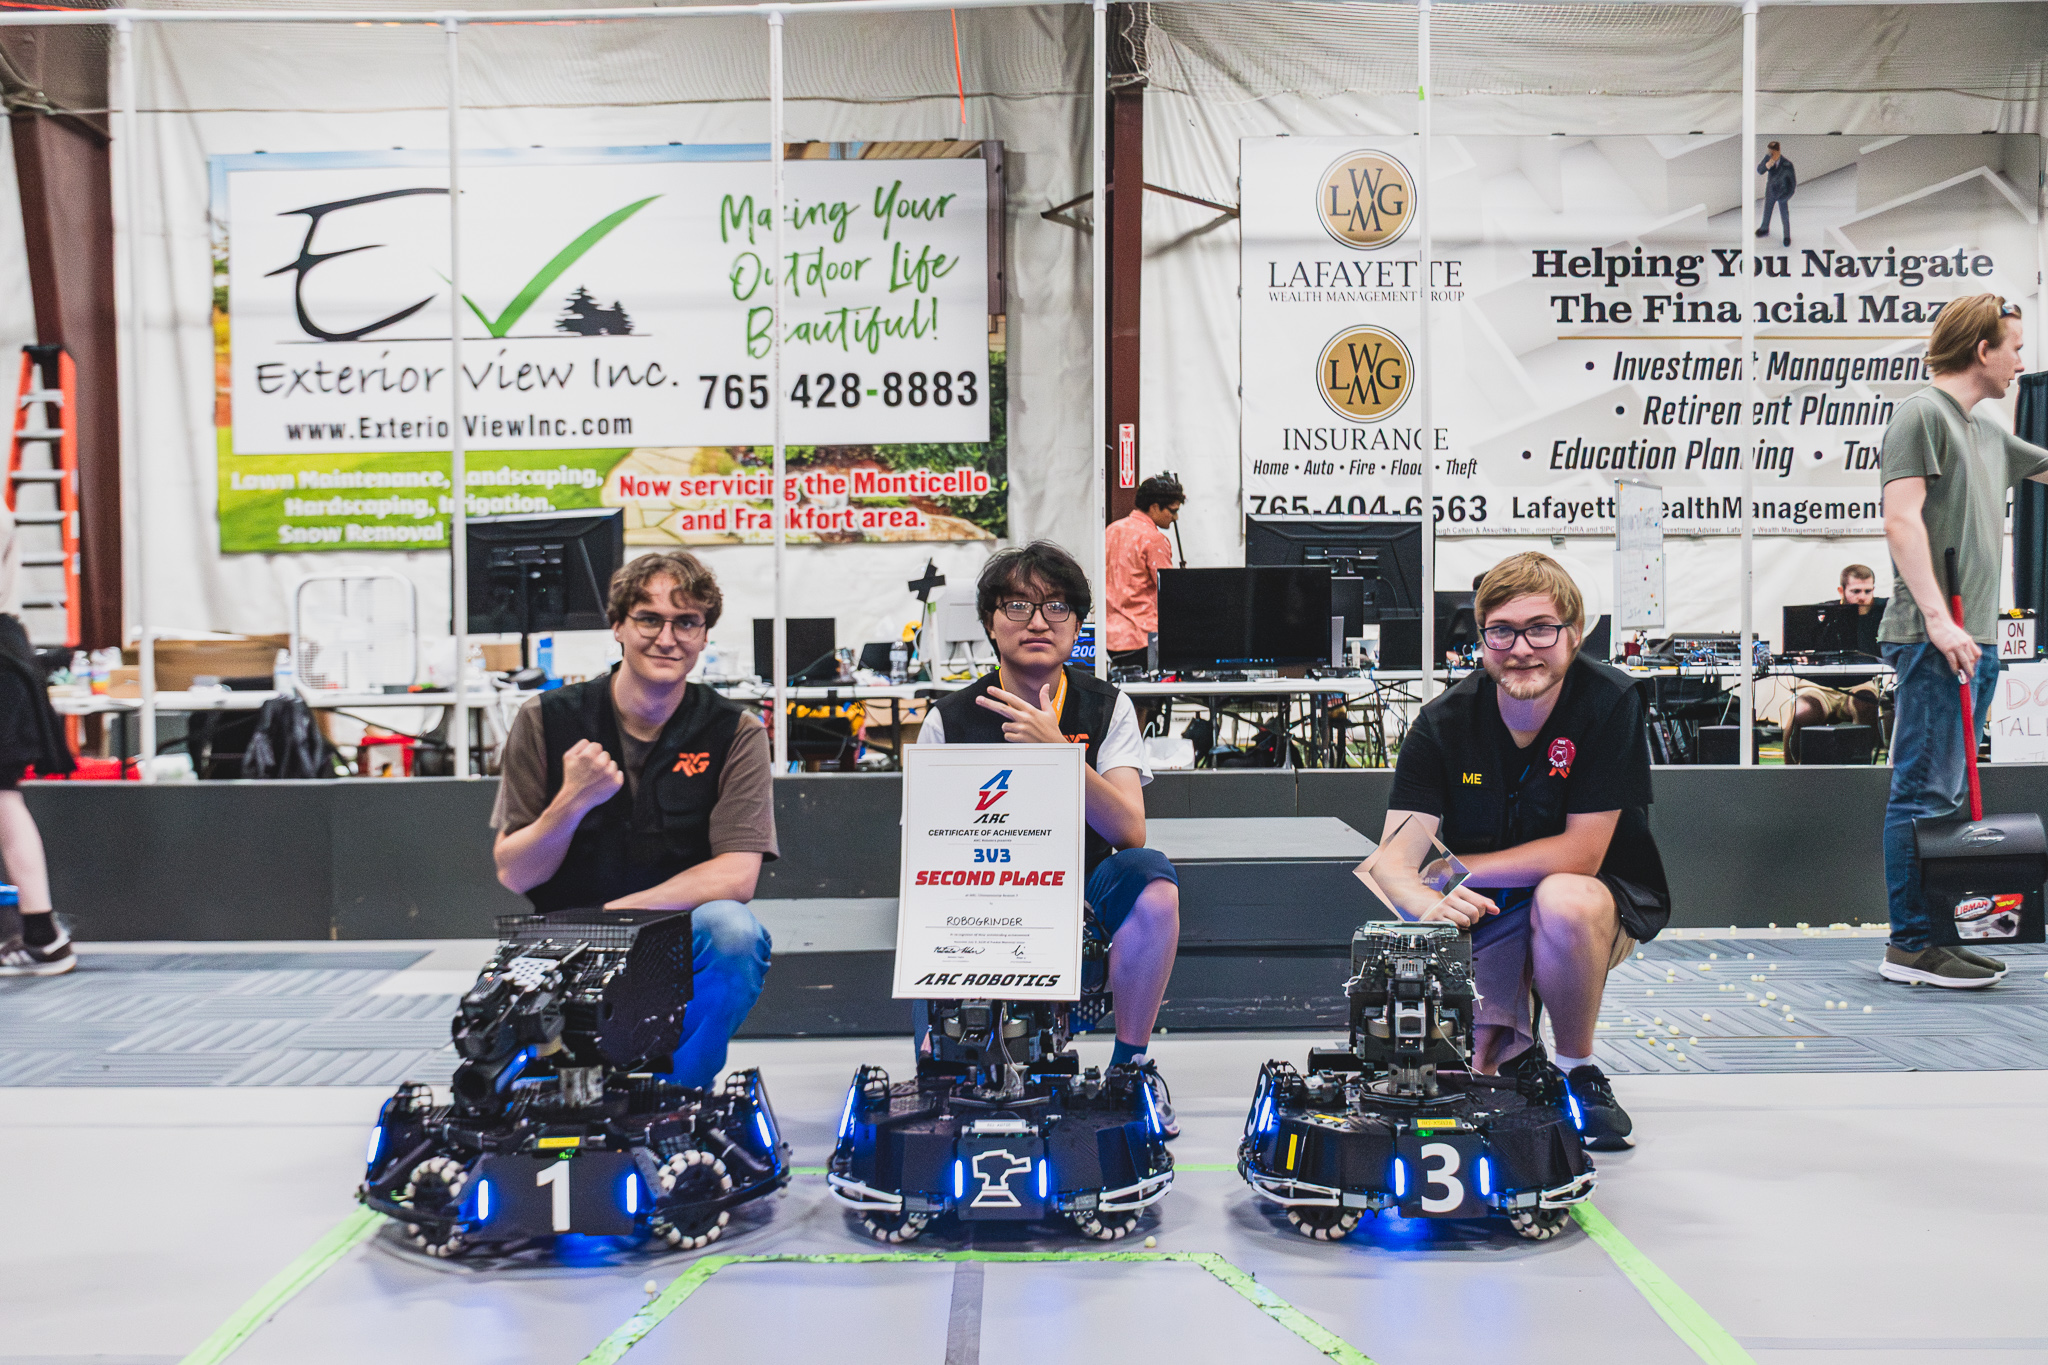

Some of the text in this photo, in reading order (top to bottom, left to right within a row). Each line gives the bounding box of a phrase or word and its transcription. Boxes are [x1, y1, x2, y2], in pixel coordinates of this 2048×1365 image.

[874, 180, 956, 240] Your
[889, 241, 959, 293] Life
[1532, 247, 1704, 287] Helping
[1801, 246, 1994, 286] Navigate
[1269, 291, 1465, 302] WEALTH MANAGEMENT ROUP
[1551, 293, 1947, 323] The Financial Maz
[747, 297, 938, 359] Bautiful!
[256, 348, 679, 397] Exterior View Inc.
[700, 371, 978, 409] 765428-8883
[1799, 395, 1899, 426] Plannin
[286, 413, 634, 440] www.ExterioViewInc.com
[1253, 459, 1289, 475] Home
[1303, 459, 1334, 475] Auto
[1349, 459, 1376, 475] Fire
[1446, 458, 1478, 479] Theft
[1550, 439, 1675, 471] Education
[1685, 440, 1795, 477] Planing
[231, 465, 604, 492] Lawn Maintenance, andscaping,
[619, 476, 671, 497] Now
[805, 471, 847, 495] the
[854, 470, 989, 494] Monticello
[284, 495, 436, 521] Hardscaping,
[682, 508, 727, 531] and
[863, 510, 926, 528] area.
[279, 520, 444, 546] Snow Removal
[1781, 527, 1823, 535] Management
[1824, 527, 1844, 535] Group
[2007, 622, 2025, 638] ON
[2003, 640, 2027, 655] AIR
[1997, 716, 2048, 737] TAL
[1462, 772, 1482, 785] ME
[973, 813, 1010, 824] ARC
[915, 870, 1066, 886] SECOND PLACE
[1955, 899, 1988, 917] LIBMAN
[946, 916, 1023, 927] ROBOGRINDER
[914, 973, 1061, 987] ARC ROBOTICS
[1420, 1142, 1464, 1212] 3
[536, 1160, 570, 1232] 1
